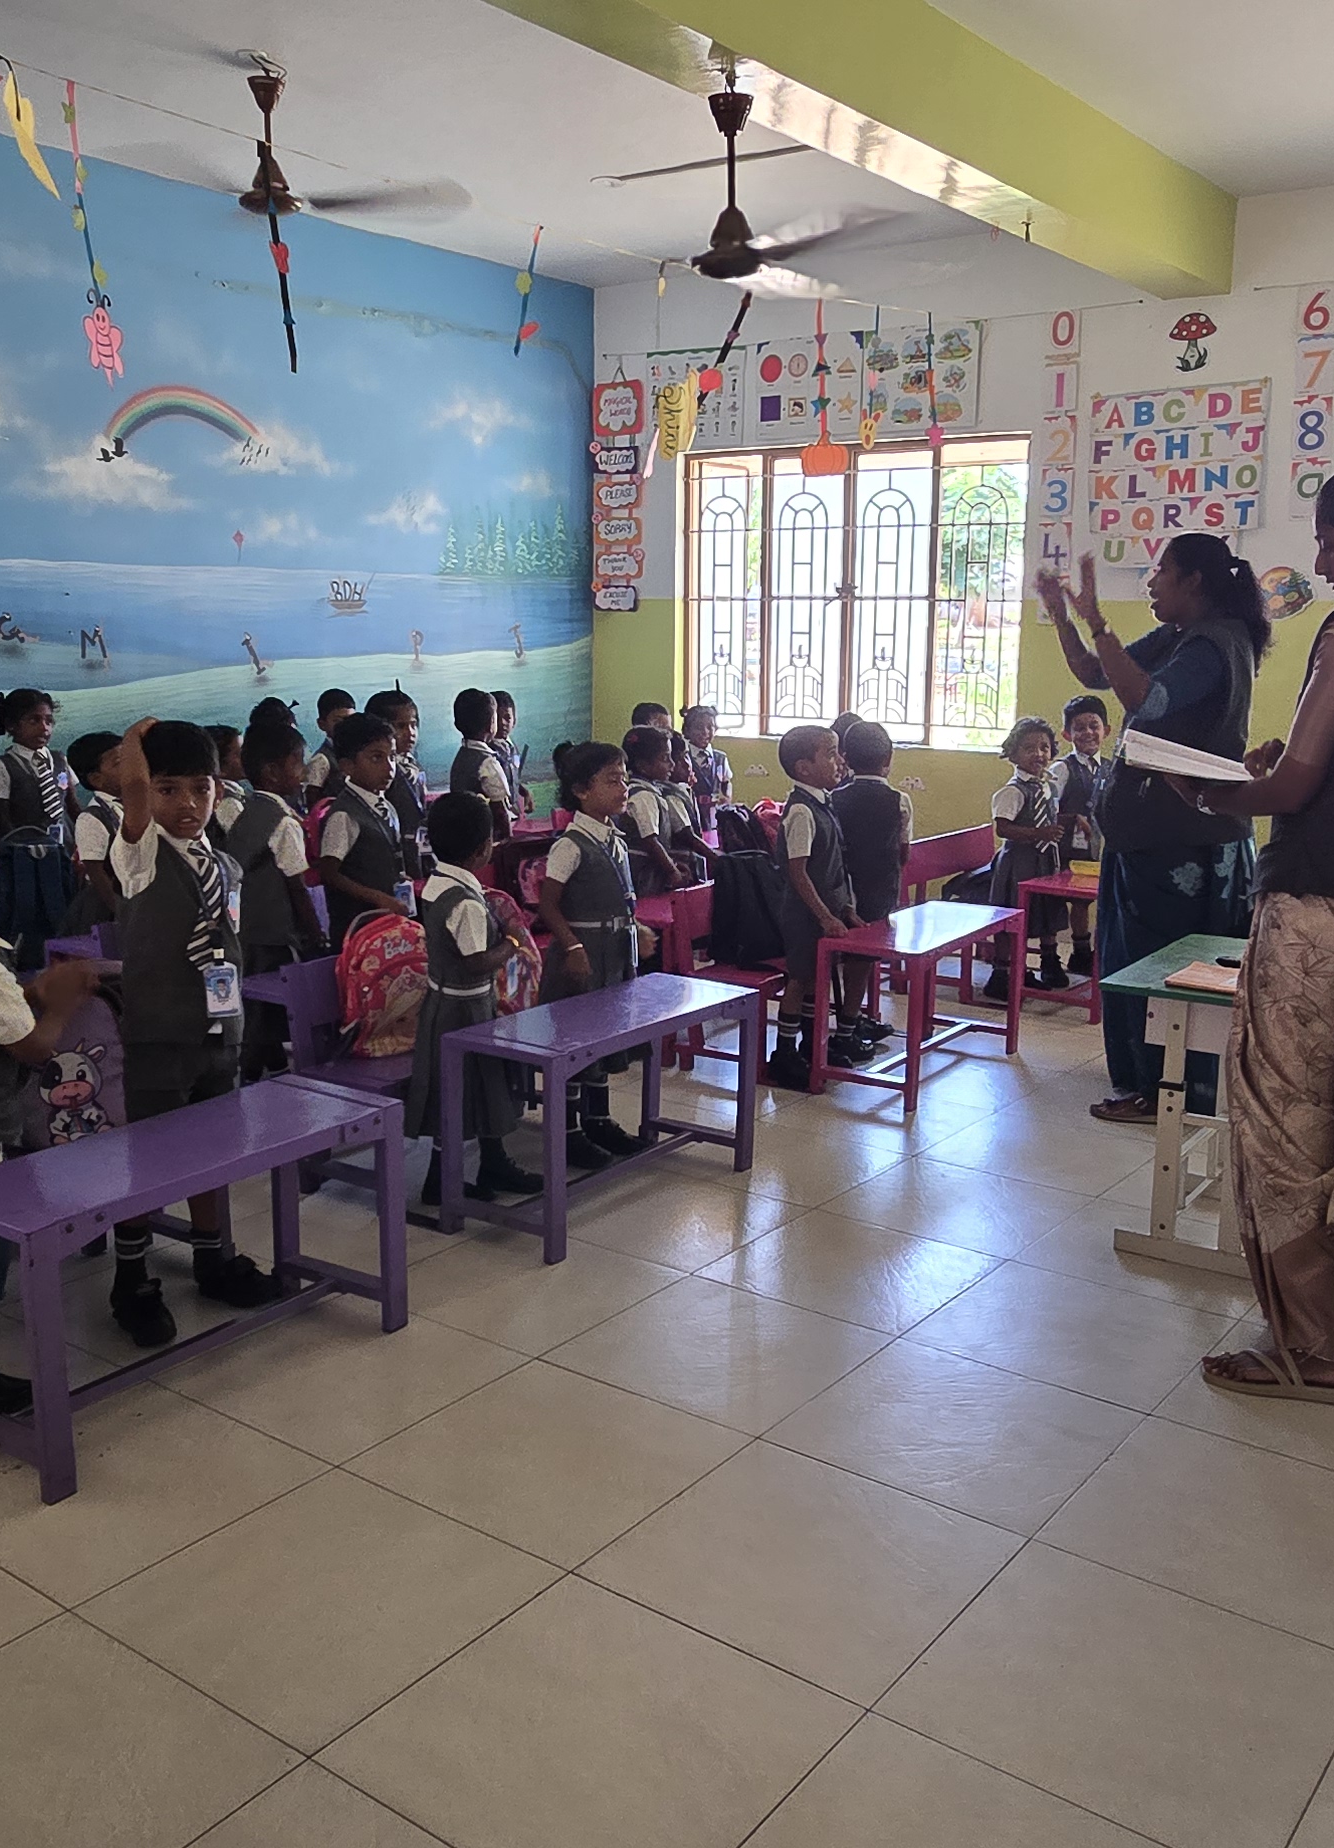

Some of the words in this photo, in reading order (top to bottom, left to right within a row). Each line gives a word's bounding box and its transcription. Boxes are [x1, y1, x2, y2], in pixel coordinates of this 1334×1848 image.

[1304, 289, 1330, 331] 6
[1052, 311, 1075, 346] 0
[1304, 350, 1331, 389] 7
[1055, 372, 1065, 408] 1
[1105, 402, 1125, 429] A
[1134, 401, 1155, 426] B
[1162, 399, 1186, 423] C
[1208, 392, 1232, 419] D
[1241, 388, 1263, 414] E
[1046, 429, 1070, 462] 2
[1094, 440, 1113, 465] F
[1134, 437, 1156, 462] G
[1165, 434, 1189, 460] H
[1200, 432, 1214, 458] I
[1241, 425, 1265, 452] J
[1298, 410, 1325, 450] 8
[604, 488, 633, 500] PLEASE
[1044, 479, 1067, 512] 3
[1094, 475, 1119, 500] K
[1128, 474, 1146, 498] L
[1167, 468, 1197, 495] M
[1204, 465, 1228, 491] N
[1235, 465, 1258, 489] O
[604, 523, 632, 535] SORRY
[1100, 509, 1121, 531] P
[1131, 507, 1155, 532] Q
[1163, 504, 1183, 528] R
[1204, 503, 1225, 527] S
[1234, 500, 1255, 525] T
[602, 556, 627, 565] THANK
[1042, 533, 1067, 565] 4
[1103, 540, 1125, 563] U
[1142, 538, 1165, 560] V
[611, 564, 624, 572] YOU
[81, 624, 108, 659] M
